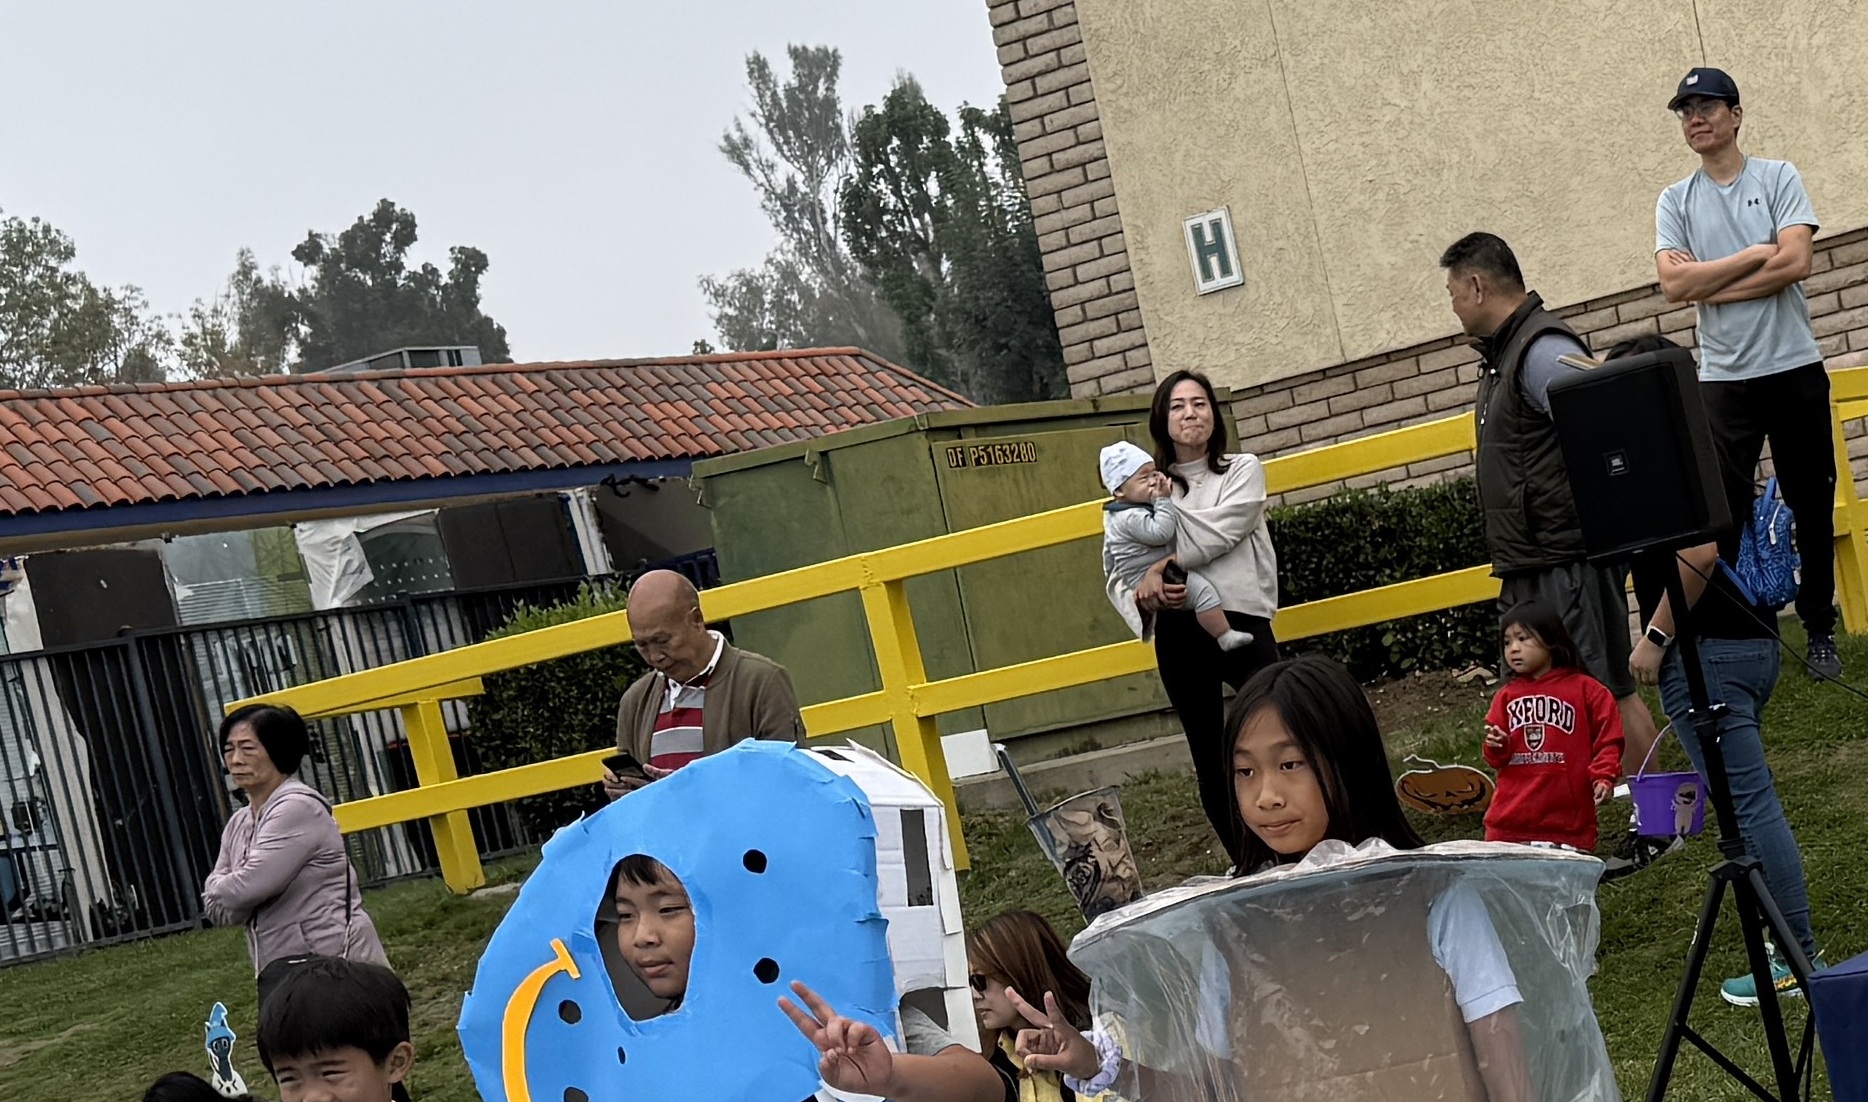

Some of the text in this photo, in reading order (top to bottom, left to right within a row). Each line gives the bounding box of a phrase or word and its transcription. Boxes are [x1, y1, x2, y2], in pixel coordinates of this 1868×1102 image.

[1190, 217, 1234, 284] H
[969, 442, 1036, 467] P5163280
[1507, 695, 1575, 735] XFORD
